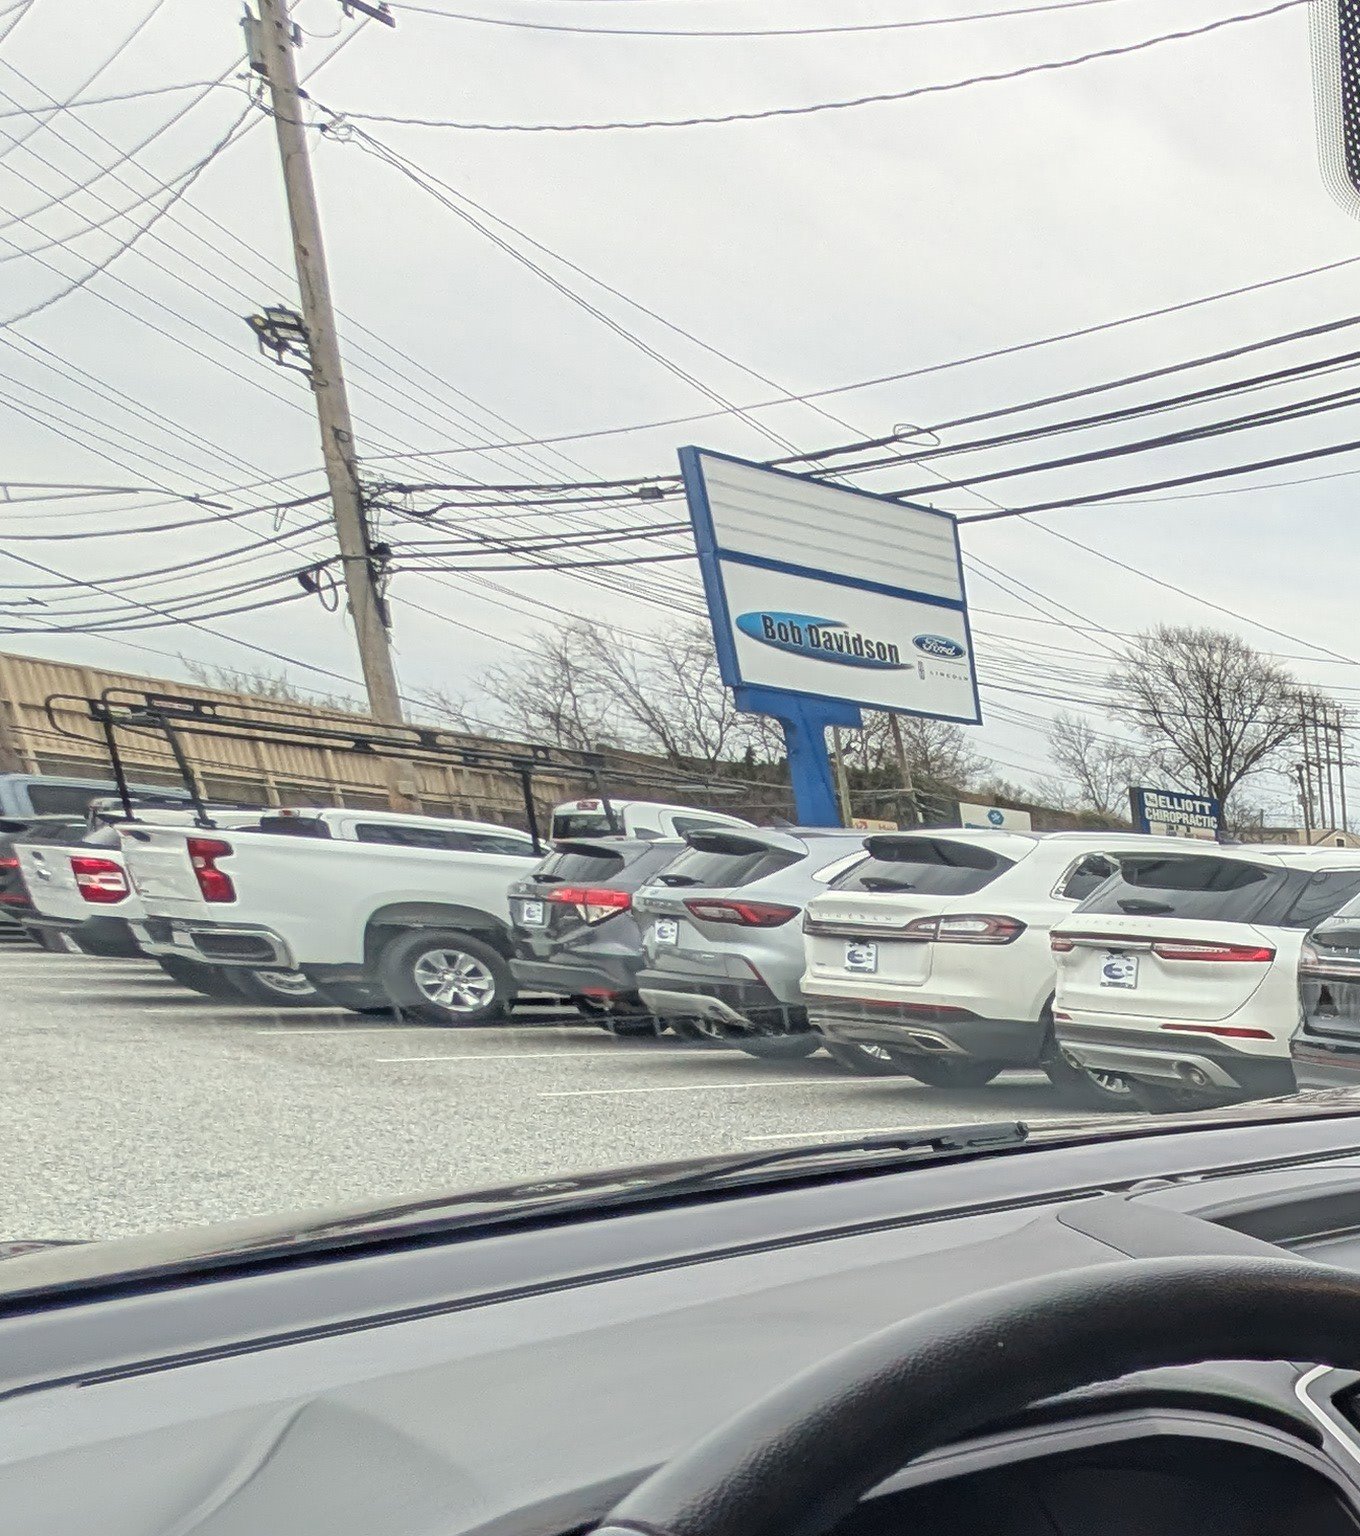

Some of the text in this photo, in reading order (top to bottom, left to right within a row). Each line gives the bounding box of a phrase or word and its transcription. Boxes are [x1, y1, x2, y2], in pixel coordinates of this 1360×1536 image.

[760, 614, 901, 664] Bob Davidson
[923, 637, 957, 656] Ford
[929, 670, 969, 682] LINCOLN
[1158, 794, 1212, 815] ELLIOTT
[1144, 806, 1218, 829] CHIROPRACTIC
